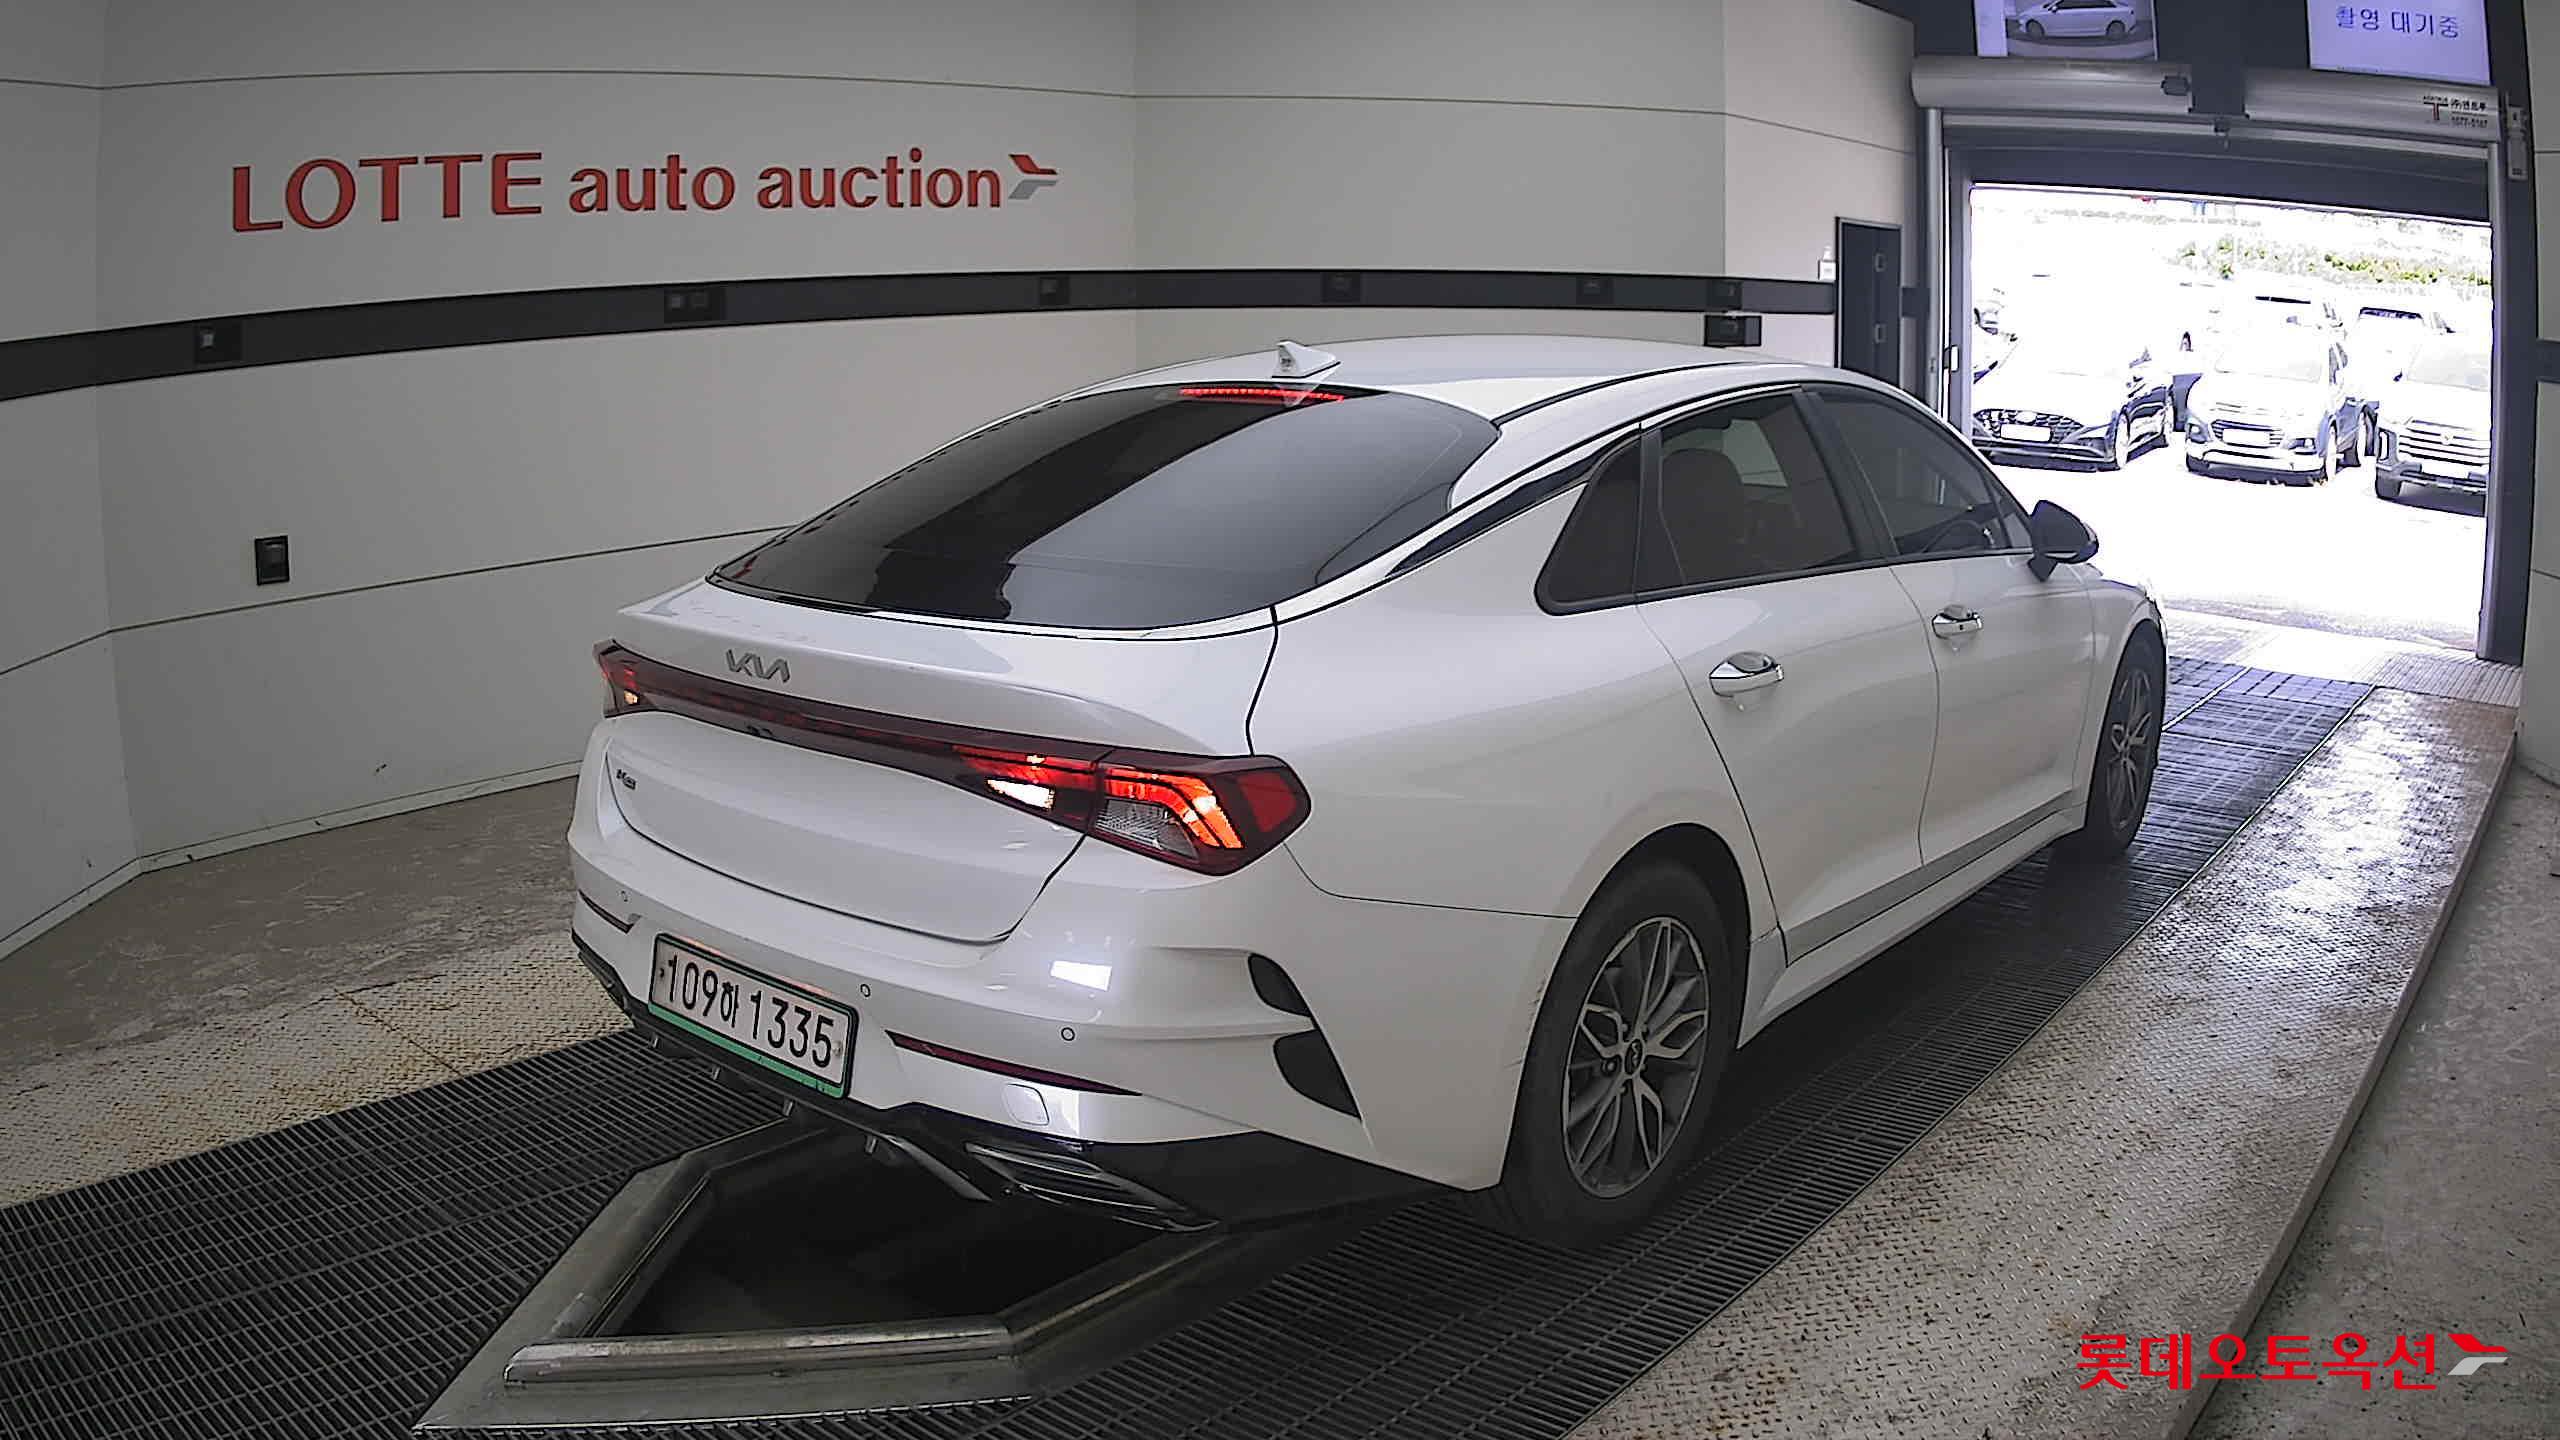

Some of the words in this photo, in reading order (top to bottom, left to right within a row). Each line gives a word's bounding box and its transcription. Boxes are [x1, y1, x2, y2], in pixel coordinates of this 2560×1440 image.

[2391, 11, 2460, 39] 대기중
[232, 151, 544, 233] LOTTE
[568, 154, 737, 214] auto
[757, 147, 1003, 211] auction
[725, 648, 792, 684] KIA
